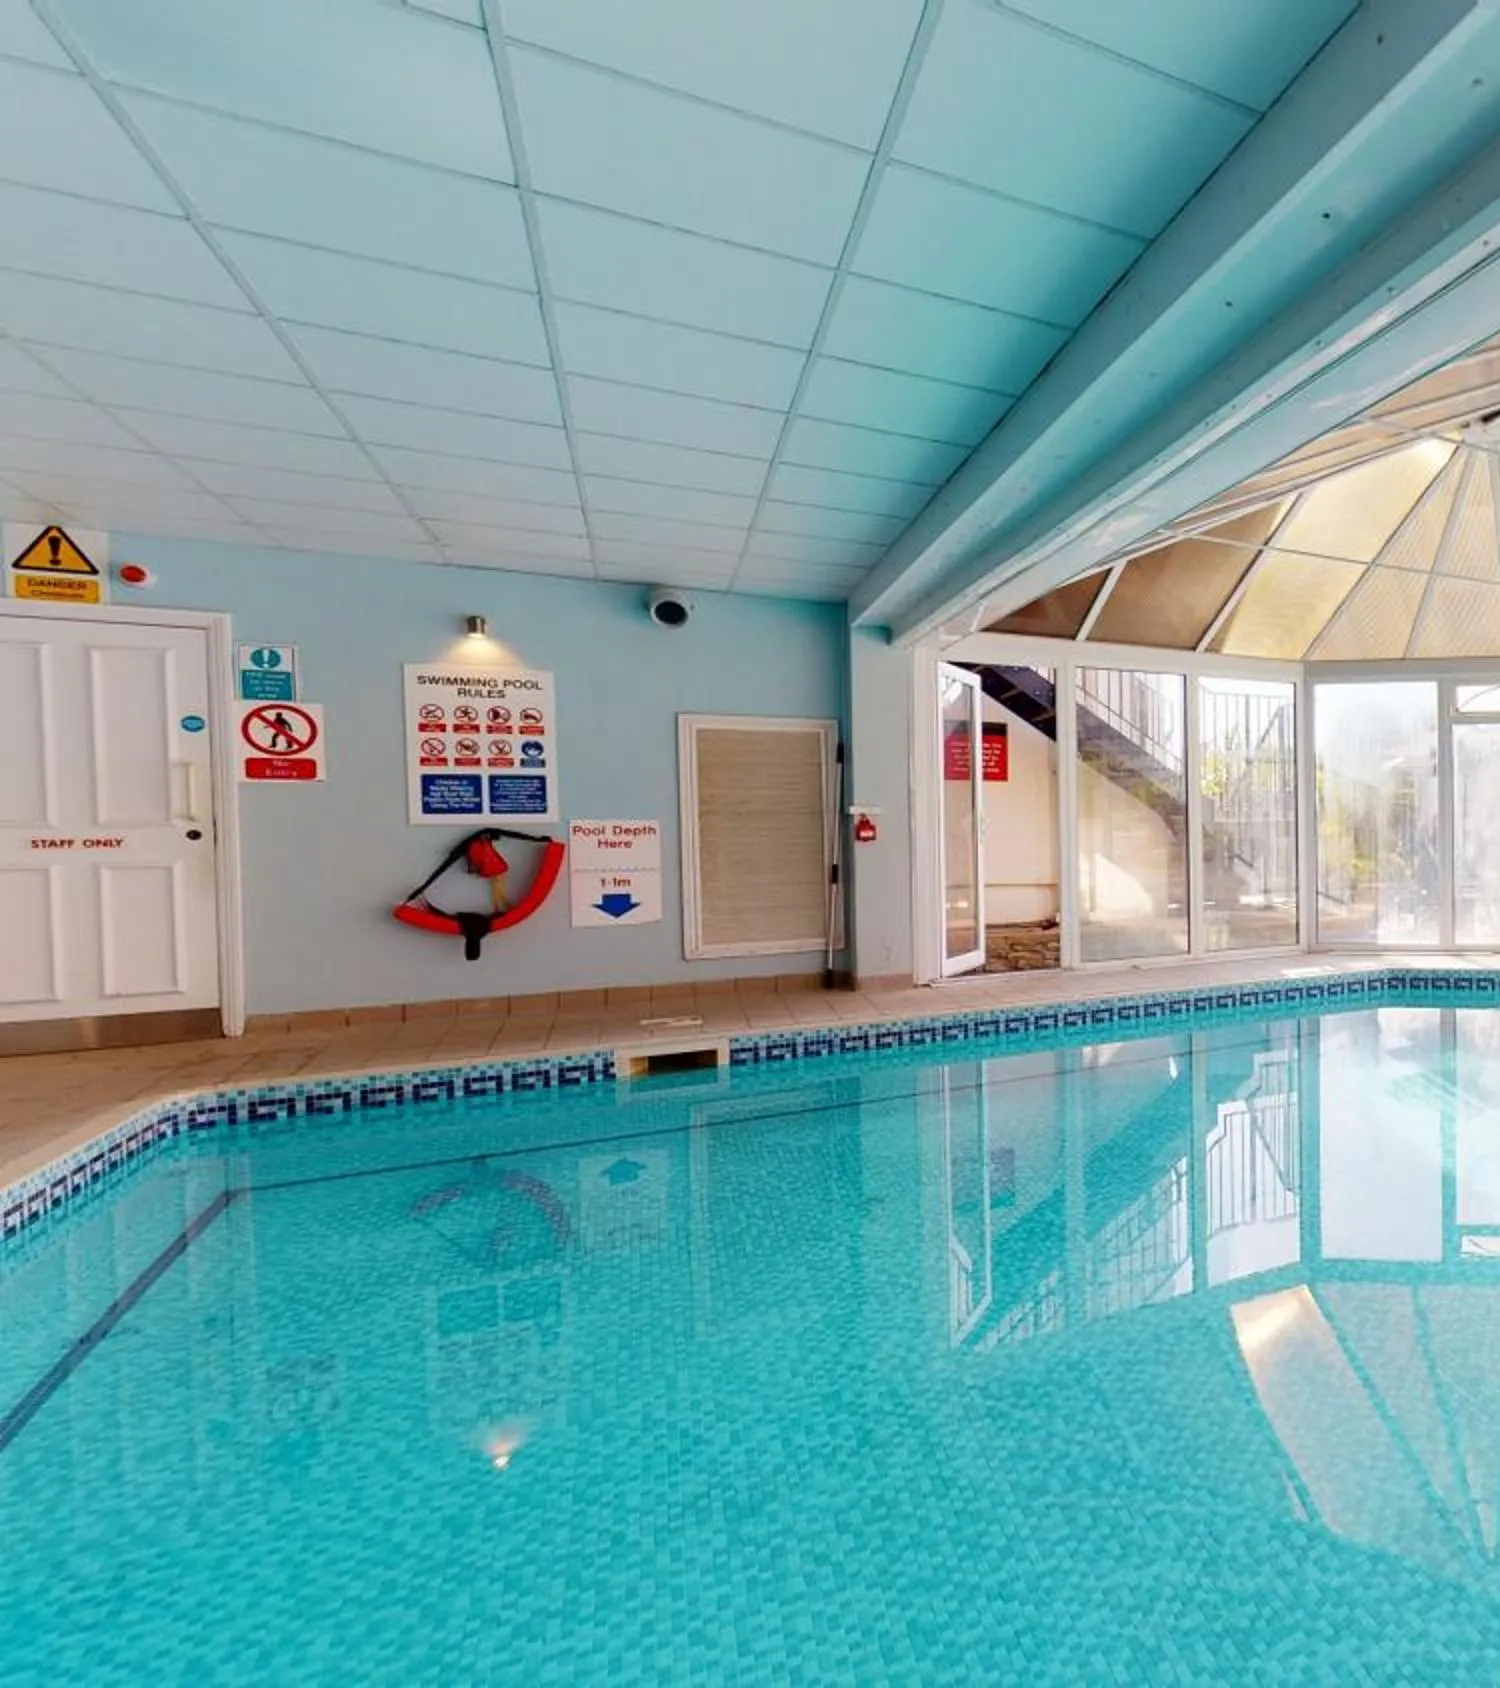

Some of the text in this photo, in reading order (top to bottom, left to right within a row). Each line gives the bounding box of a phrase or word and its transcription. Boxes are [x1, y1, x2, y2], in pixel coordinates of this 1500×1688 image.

[416, 675, 543, 690] SWIMMING POOL
[457, 688, 505, 699] RULES
[573, 825, 657, 836] Pool Depth
[31, 839, 124, 849] STAFF ONLY
[597, 839, 633, 849] Here
